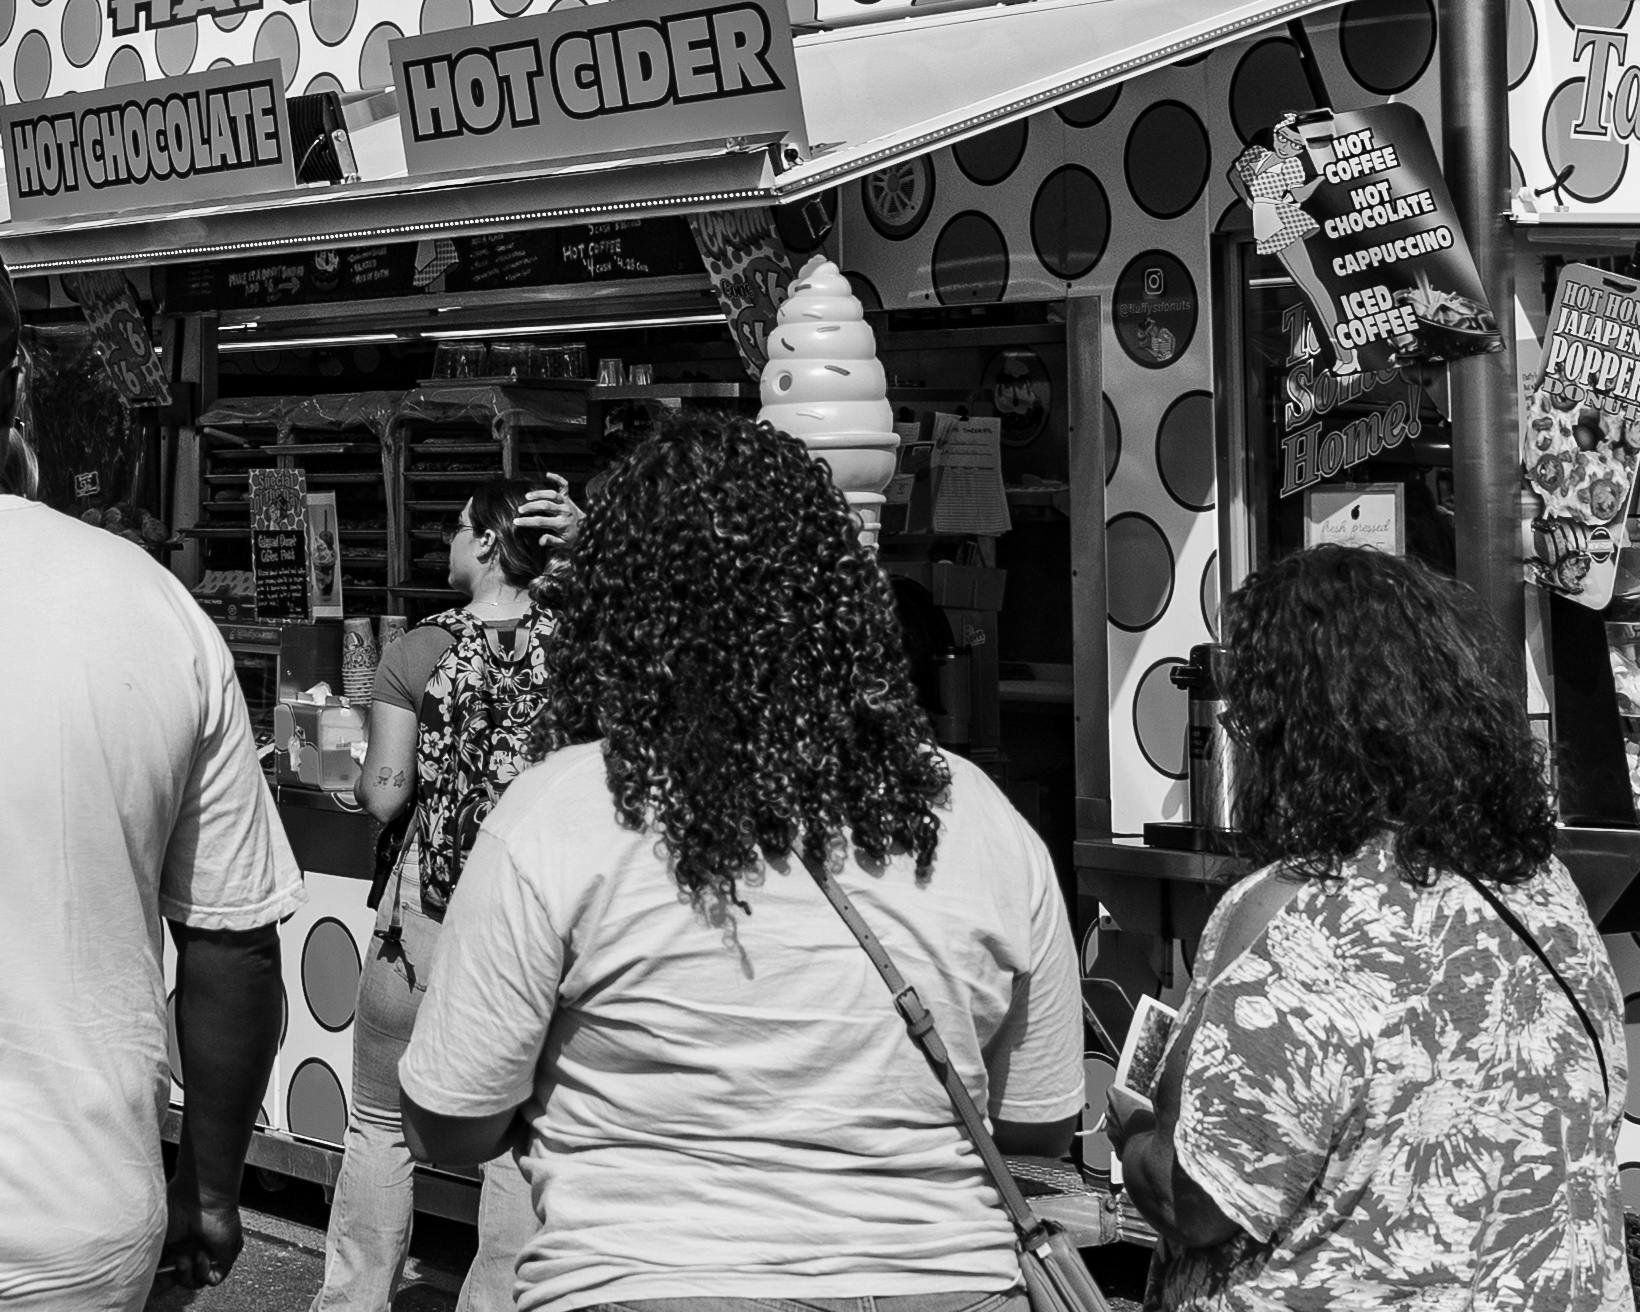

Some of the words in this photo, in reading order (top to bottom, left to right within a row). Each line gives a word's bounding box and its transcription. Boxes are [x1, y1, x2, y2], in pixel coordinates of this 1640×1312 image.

[403, 38, 544, 142] HOT
[550, 1, 785, 120] CIDER
[10, 112, 79, 198] HOT
[79, 78, 282, 188] CHOCOLATE
[1332, 128, 1375, 159] HOT
[1323, 144, 1400, 184] COFFEE
[1350, 179, 1392, 209] HOT
[1323, 189, 1437, 240] CHOCOLATE
[562, 242, 585, 262] HOT
[588, 238, 621, 256] COFFEE
[1331, 225, 1454, 277] CAPPUCCINO
[1340, 284, 1393, 320] ICED
[1560, 280, 1604, 314] HOT
[1334, 305, 1420, 349] COFFEE
